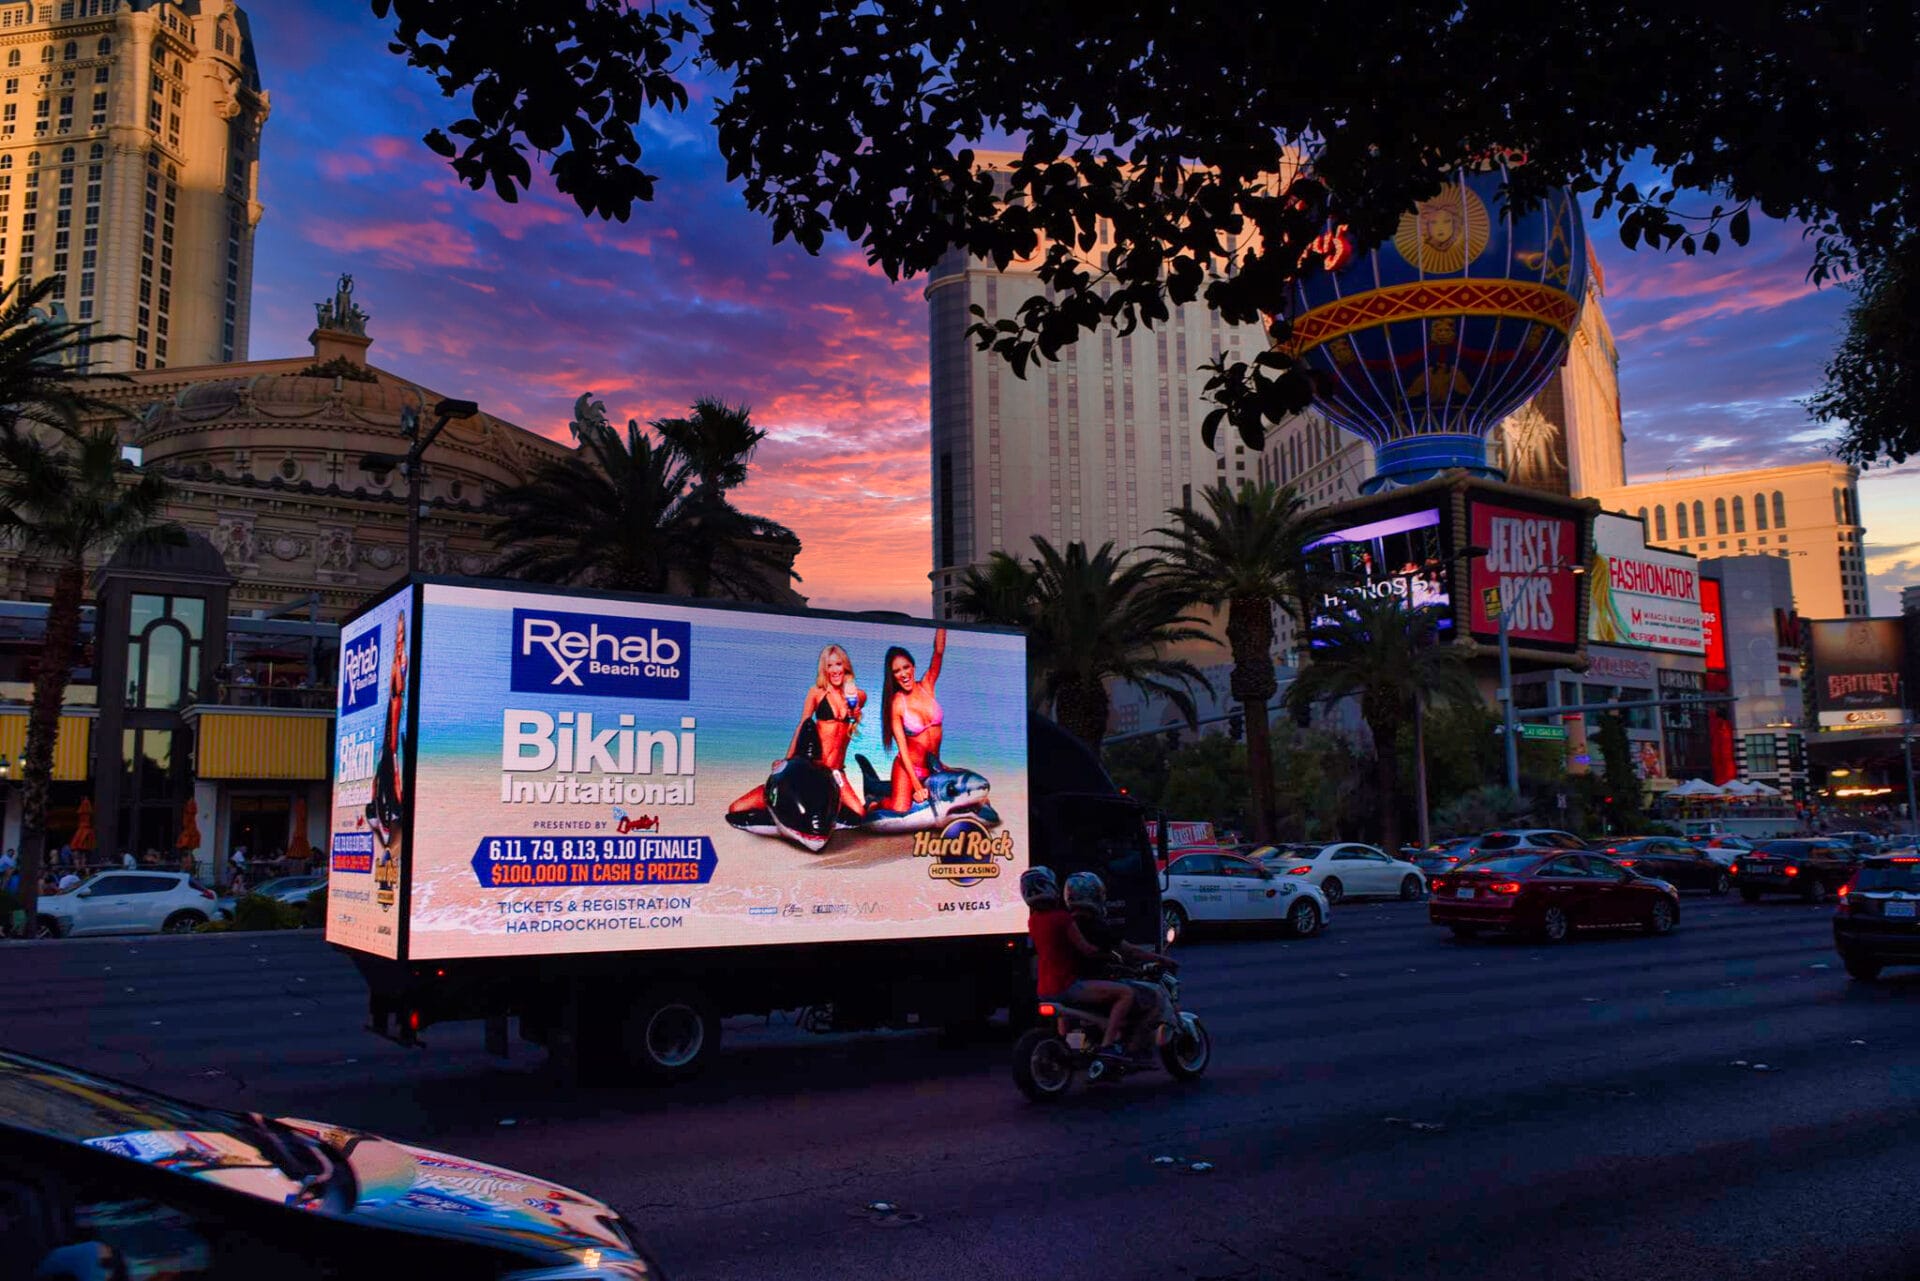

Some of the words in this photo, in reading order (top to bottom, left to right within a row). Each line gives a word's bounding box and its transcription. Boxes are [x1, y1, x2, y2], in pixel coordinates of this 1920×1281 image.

[1486, 517, 1561, 575] JERSEY
[1609, 557, 1696, 600] FASHIONATOR
[1499, 576, 1554, 631] BOYS
[522, 618, 681, 668] Rehab
[345, 637, 378, 684] Rehab
[589, 661, 640, 676] Beach
[644, 665, 680, 679] Club
[1828, 673, 1899, 699] BRITNEY
[502, 709, 697, 775] Bikini
[501, 774, 696, 805] Invitational
[533, 821, 592, 830] PRESENTED
[594, 821, 607, 829] BY
[489, 840, 526, 862] 6.11,
[531, 840, 558, 862] 7.9,
[562, 840, 600, 861] 8.13,
[603, 839, 636, 860] 9.10
[640, 838, 701, 860] [FINALE]
[913, 831, 965, 857] Hard
[967, 830, 1014, 860] Rock
[492, 864, 567, 885] $100,000
[571, 864, 588, 882] IN
[592, 864, 631, 882] CASH
[635, 864, 644, 881] &
[648, 863, 699, 881] PRIZES
[931, 867, 957, 875] HOTEL
[967, 866, 997, 874] CASINO
[498, 901, 563, 915] TICKETS
[567, 901, 577, 912] &
[583, 897, 691, 913] REGISTRATION
[938, 902, 955, 911] LAS
[958, 901, 990, 911] VEGAS
[507, 917, 682, 933] HARDROCKHOTEL.COM
